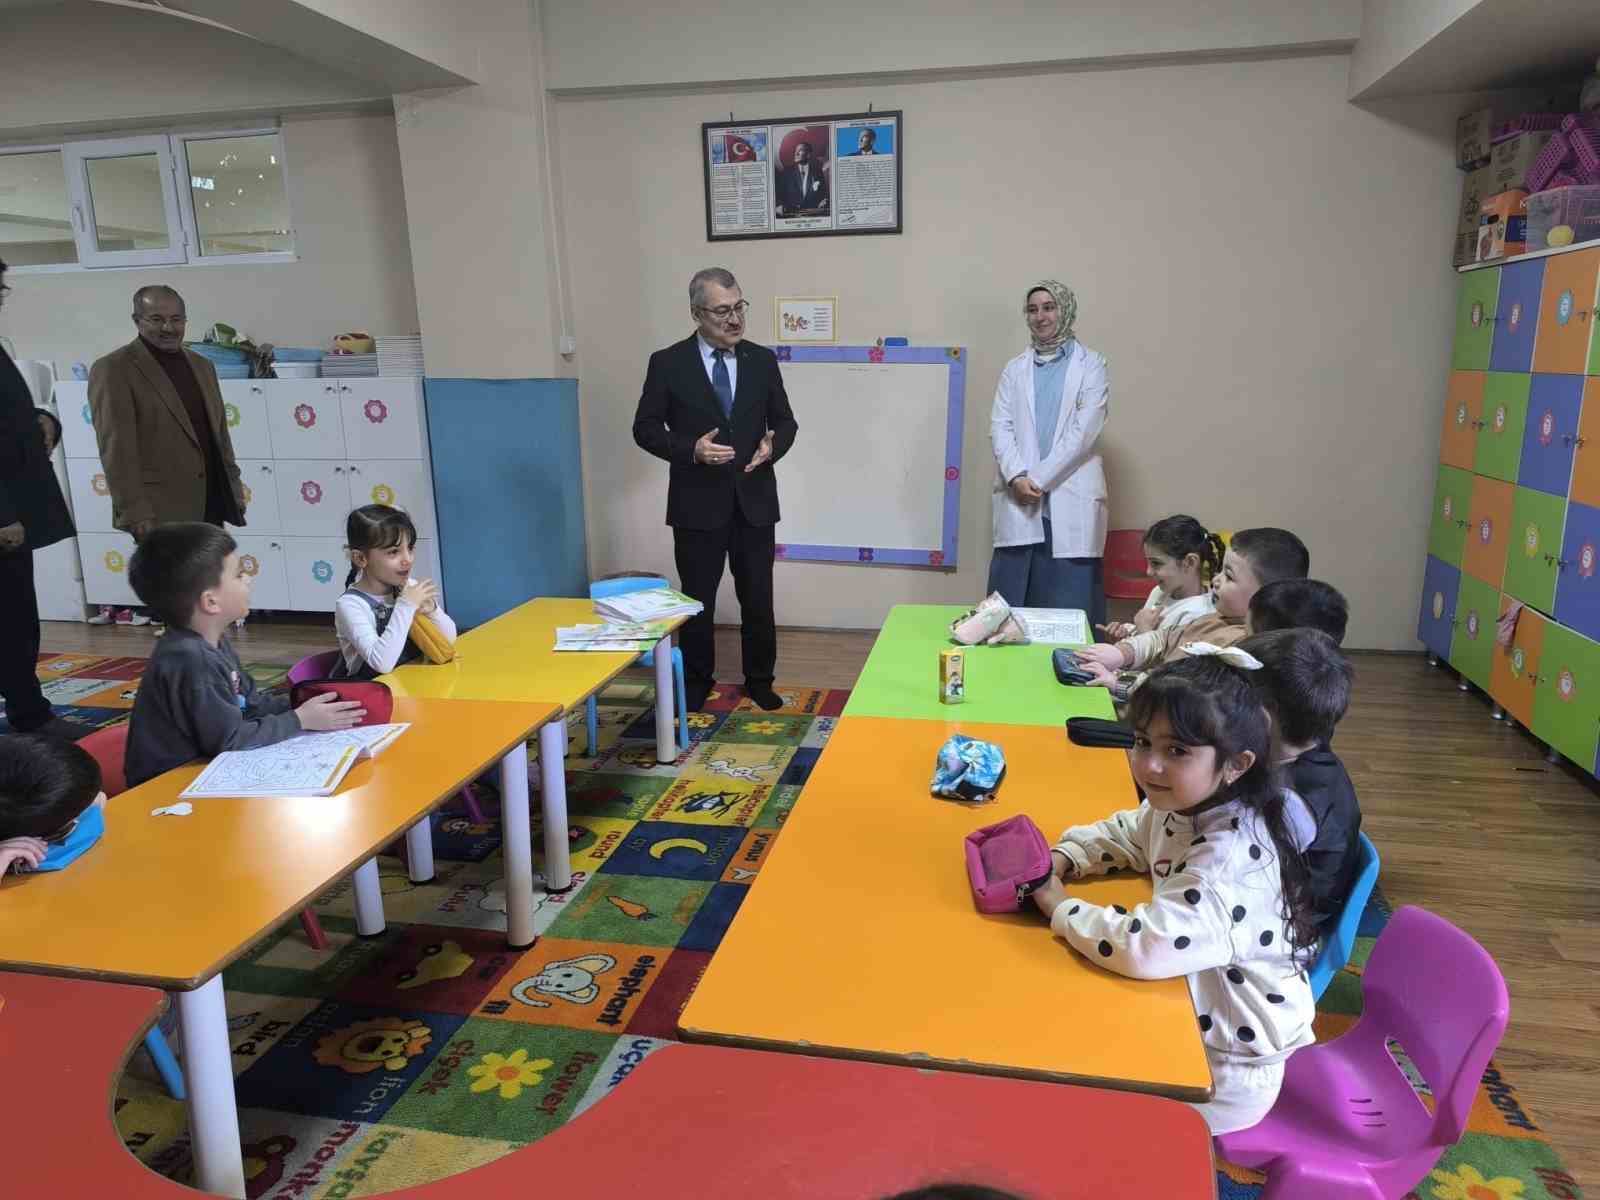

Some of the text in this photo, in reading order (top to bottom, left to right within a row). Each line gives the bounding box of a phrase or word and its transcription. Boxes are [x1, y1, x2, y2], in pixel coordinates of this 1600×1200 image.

[589, 830, 622, 859] round
[744, 833, 769, 864] yunus
[481, 999, 511, 1015] fil
[596, 954, 656, 1026] elephant
[232, 1020, 290, 1055] bird
[352, 1075, 408, 1117] lion
[535, 1050, 600, 1116] flower
